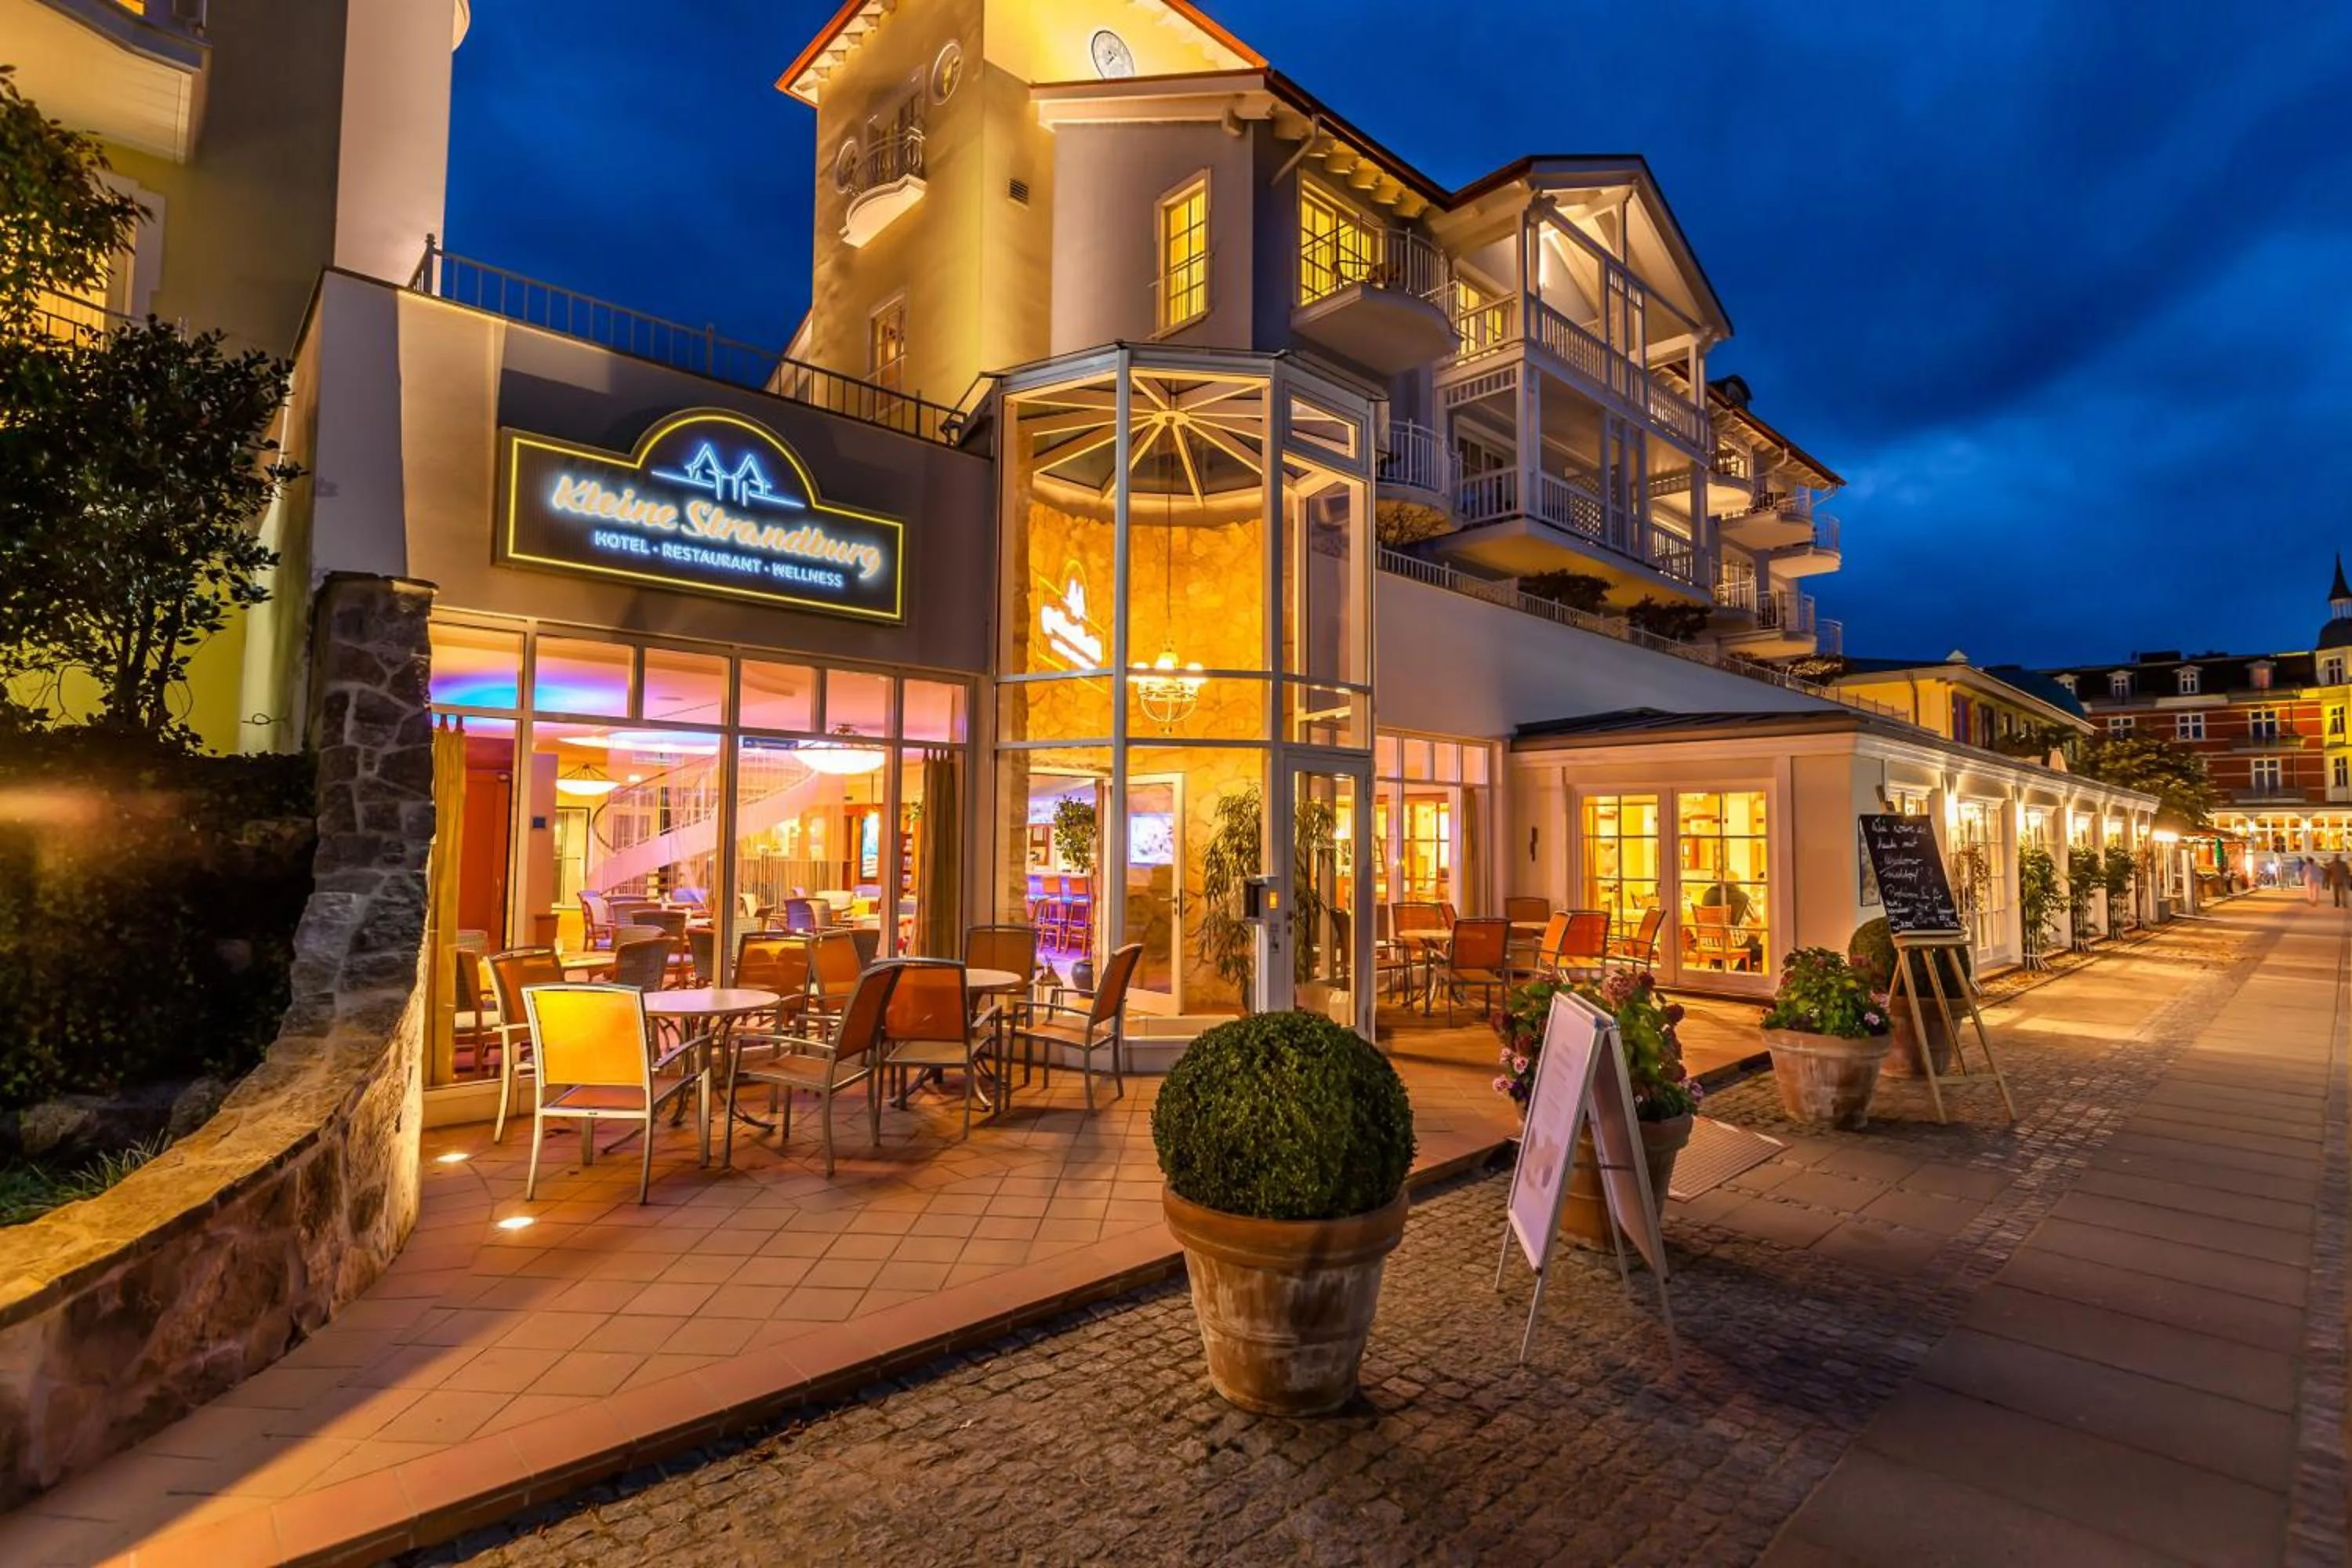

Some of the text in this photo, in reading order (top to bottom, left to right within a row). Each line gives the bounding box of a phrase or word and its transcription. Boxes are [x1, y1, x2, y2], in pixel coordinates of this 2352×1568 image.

[552, 476, 880, 579] Kleine Strandburg
[594, 530, 844, 588] HOTEL RESTAURANT WELLNESS
